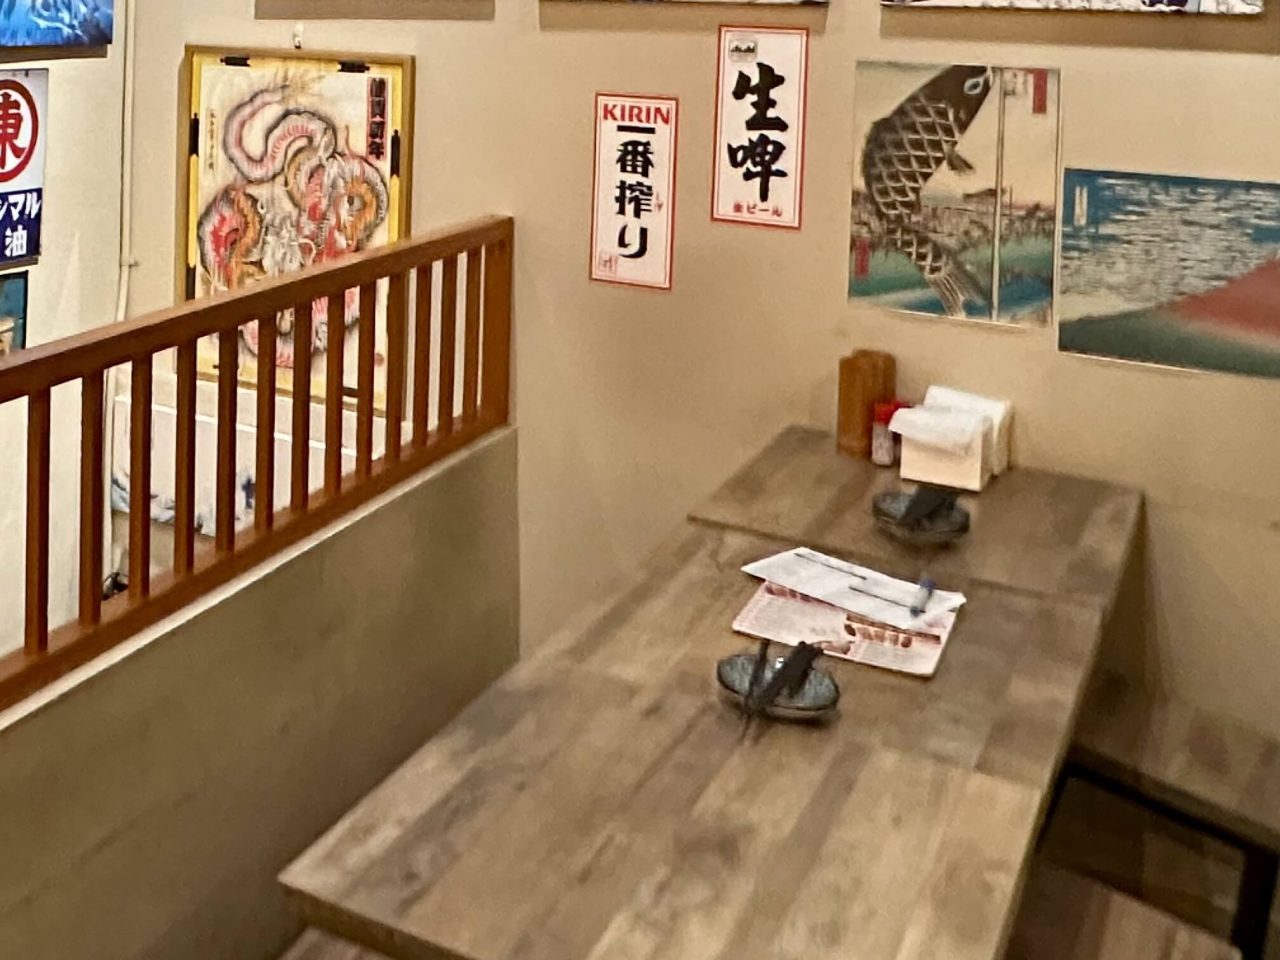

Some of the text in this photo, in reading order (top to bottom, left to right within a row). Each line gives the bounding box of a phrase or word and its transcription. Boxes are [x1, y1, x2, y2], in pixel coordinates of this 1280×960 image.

[602, 103, 670, 125] KIRIN
[727, 62, 789, 203] 生啤
[614, 125, 656, 260] 一番搾り
